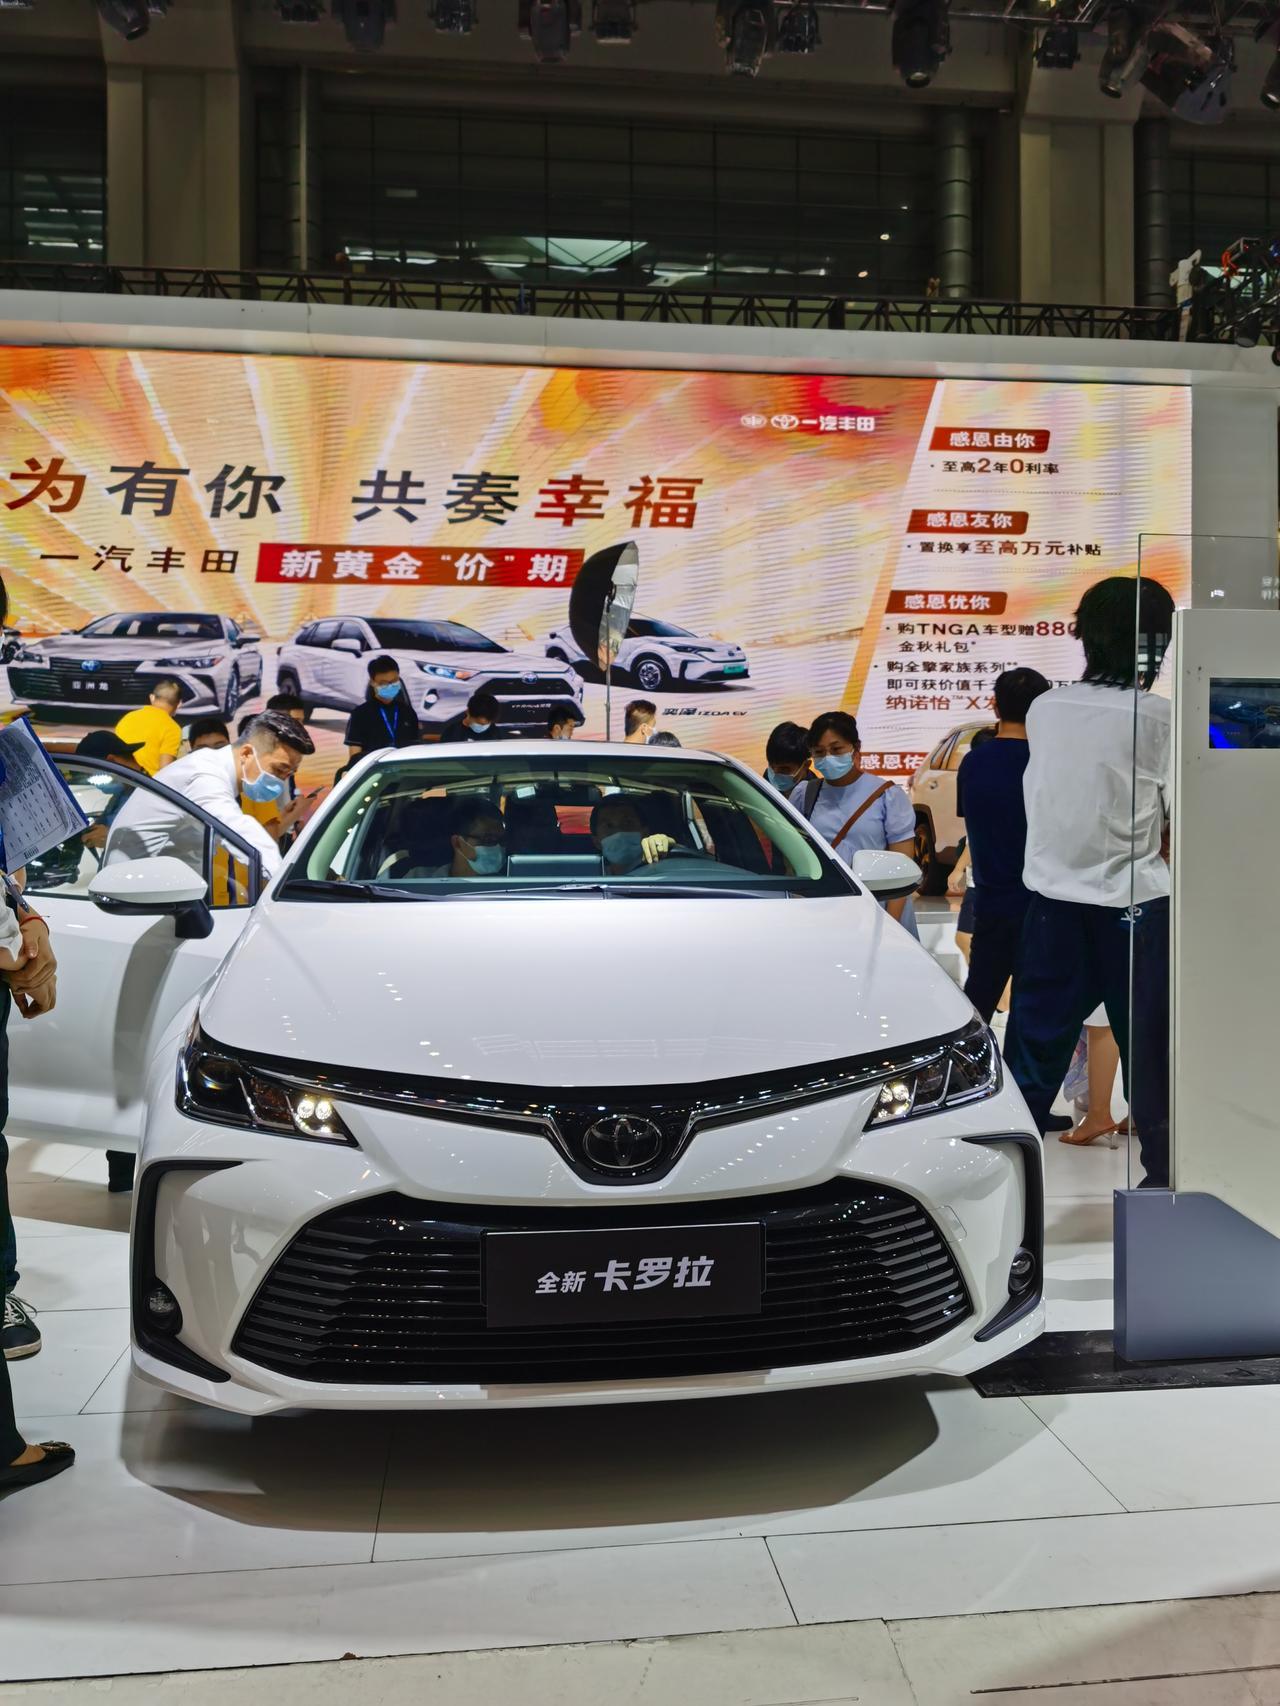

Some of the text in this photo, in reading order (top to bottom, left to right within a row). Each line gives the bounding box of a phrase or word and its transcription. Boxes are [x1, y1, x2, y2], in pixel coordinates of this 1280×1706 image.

[801, 415, 876, 432] 一汽丰田
[949, 431, 1036, 449] 感恩由你
[941, 457, 1060, 475] 至高2年0利率
[5, 457, 704, 529] 为有你 共奏幸福
[926, 511, 1013, 529] 感恩友你
[919, 539, 1102, 556] 置换享至高万元补贴
[39, 545, 239, 574] 一汽丰田
[903, 593, 991, 611] 感恩优你
[535, 1255, 715, 1294] 全新 卡罗拉
